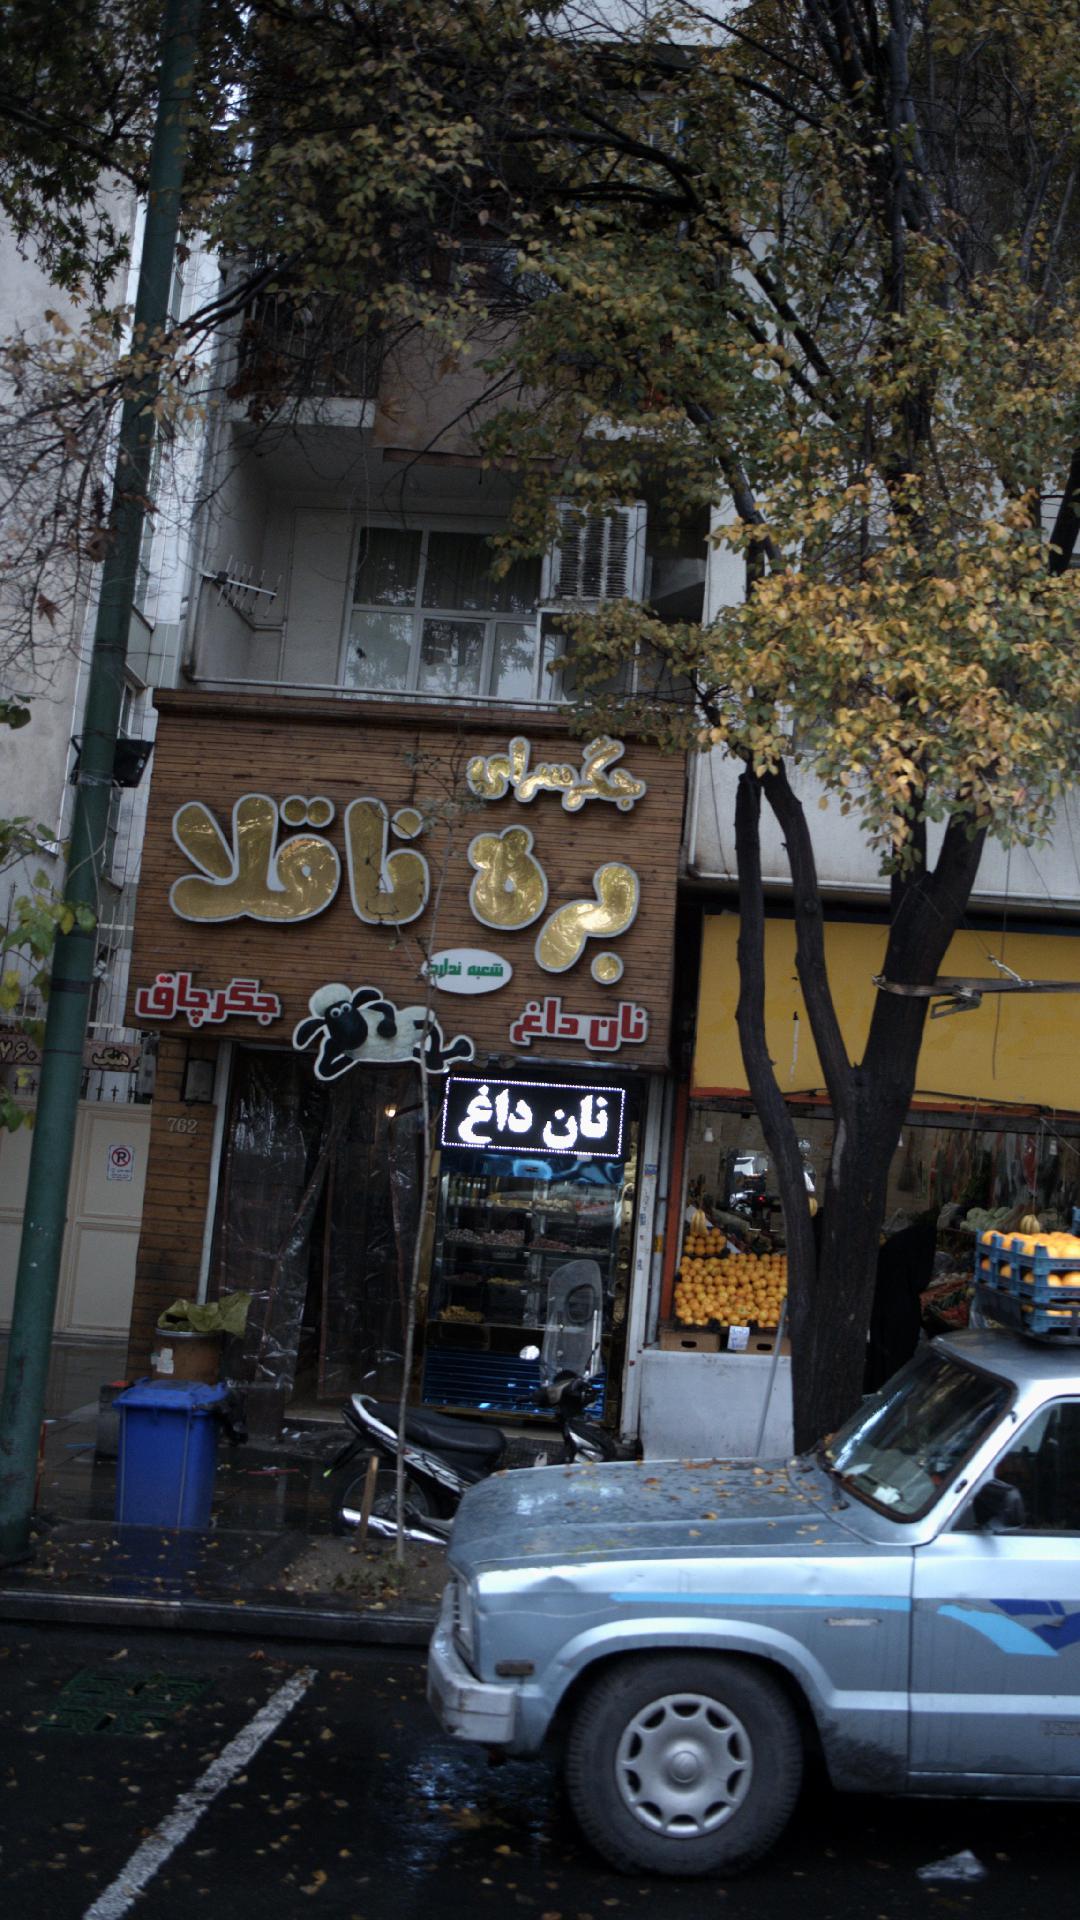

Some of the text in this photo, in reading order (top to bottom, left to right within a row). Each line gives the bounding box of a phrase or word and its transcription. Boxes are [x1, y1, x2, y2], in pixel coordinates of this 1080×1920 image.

[169, 793, 430, 925] ناقلا
[428, 958, 503, 980] شعبه ندارد
[510, 997, 648, 1051] نان داغ
[167, 1117, 199, 1134] 762
[457, 1084, 609, 1149] نان داغ
